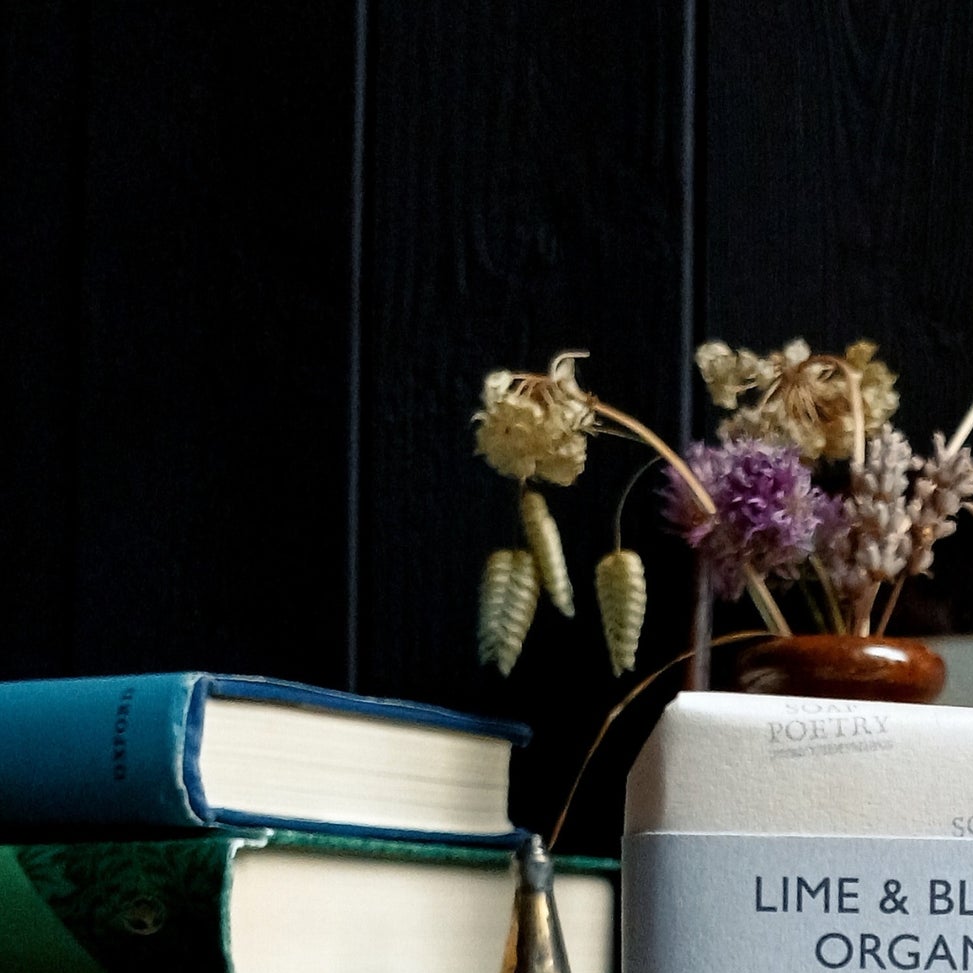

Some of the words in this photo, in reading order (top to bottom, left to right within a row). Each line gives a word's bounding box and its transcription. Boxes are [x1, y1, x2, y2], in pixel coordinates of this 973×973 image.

[767, 715, 887, 743] POETRY
[755, 875, 860, 914] LIME
[878, 878, 910, 916] &
